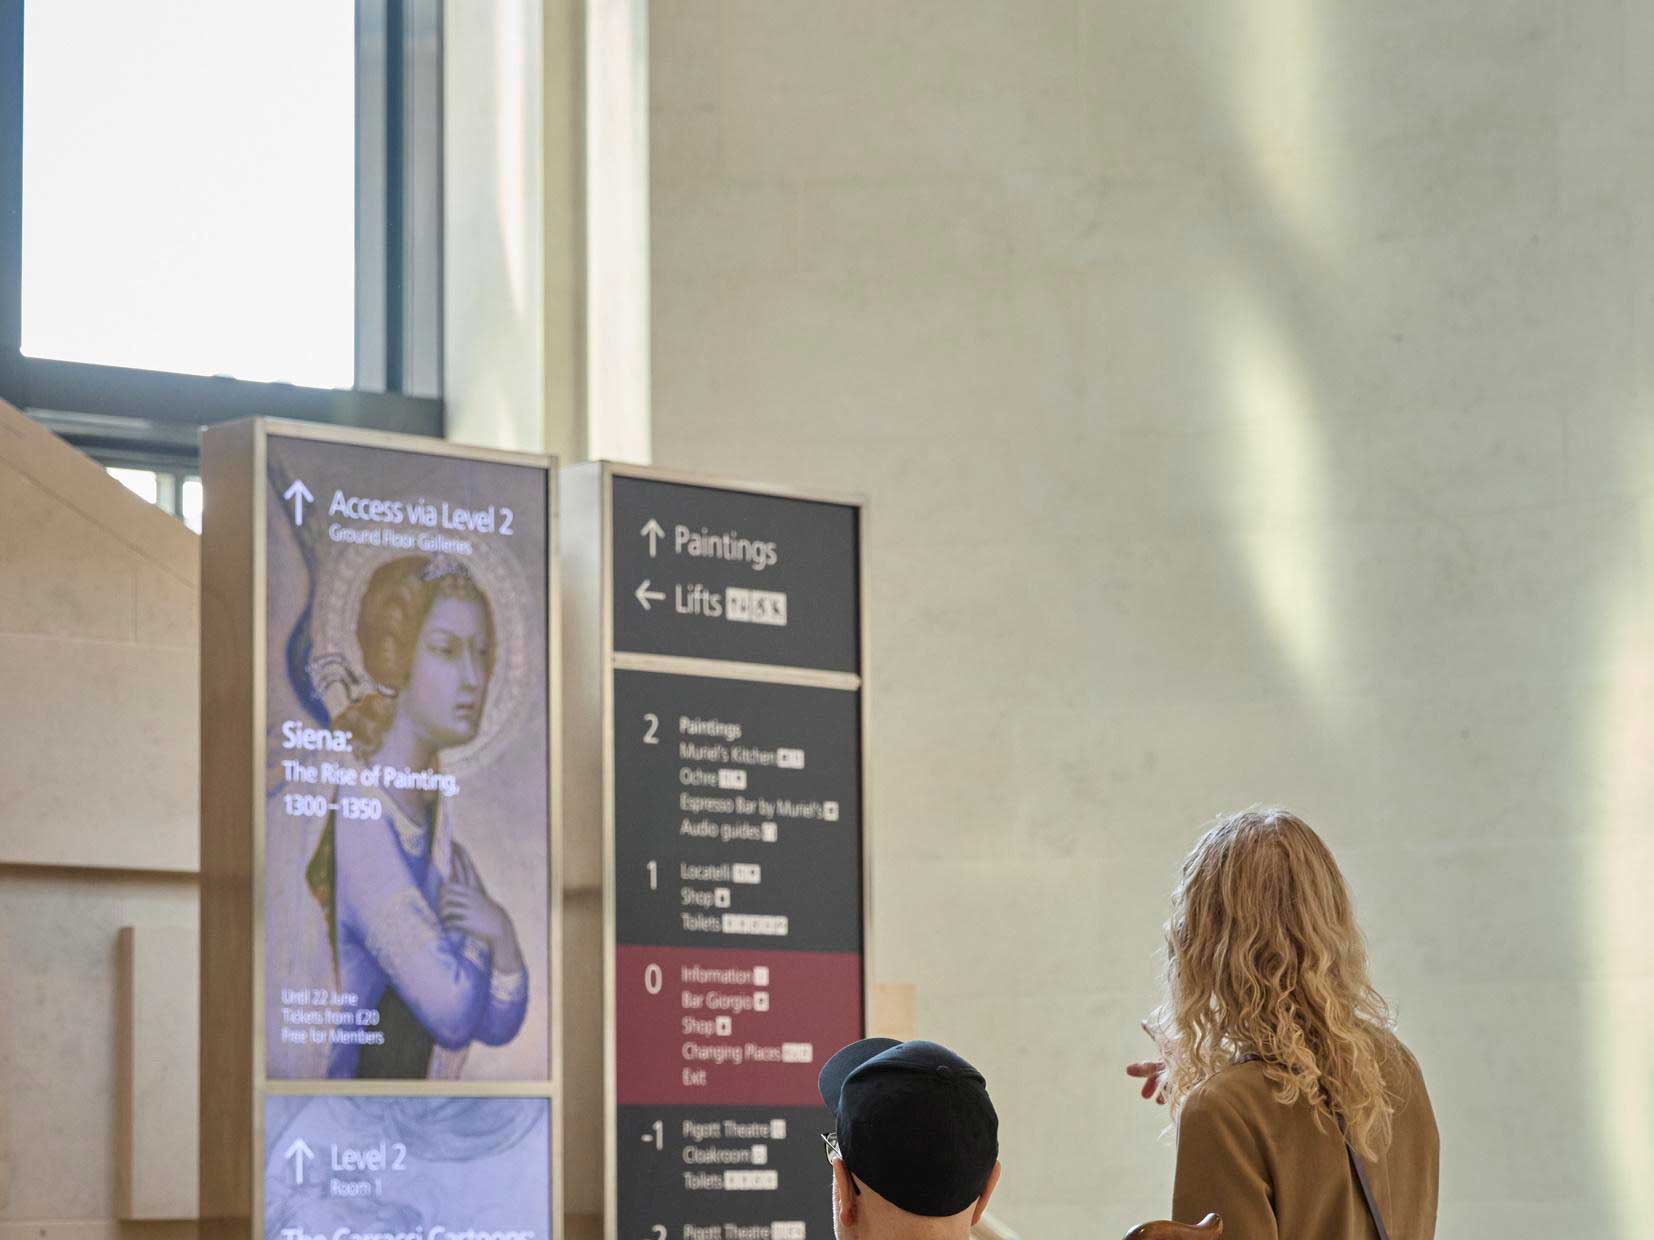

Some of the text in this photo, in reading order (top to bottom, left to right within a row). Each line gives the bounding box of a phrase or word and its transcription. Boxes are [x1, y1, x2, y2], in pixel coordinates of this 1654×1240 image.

[329, 490, 514, 535] Access via Level 2
[329, 523, 380, 546] Ground
[675, 524, 778, 571] Paintings
[675, 583, 723, 617] Lifts
[281, 720, 353, 752] Siena:
[643, 713, 659, 744] 2
[679, 715, 742, 741] Paintings
[731, 745, 777, 766] Kitchen
[282, 760, 460, 797] The Rise of Painting,
[679, 766, 718, 786] Ochre
[679, 791, 734, 814] Espresso
[736, 795, 757, 815] Bar
[680, 816, 761, 842] Audio guides
[646, 860, 658, 890] 1
[680, 887, 714, 909] Shop
[680, 912, 721, 932] Toilets
[644, 963, 662, 994] 0
[681, 964, 752, 984] Information
[281, 986, 359, 1006] Until 22 June
[681, 990, 704, 1009] Bar
[282, 1007, 380, 1025] Tickets from £20
[681, 1015, 715, 1038] Shop
[281, 1027, 384, 1045] Free for Members
[682, 1042, 781, 1064] Changing Places
[682, 1067, 706, 1086] Exit
[640, 1120, 663, 1150] -1
[723, 1119, 770, 1139] Theatre
[331, 1141, 407, 1171] Level 2
[331, 1179, 383, 1197] Room 1
[683, 1171, 724, 1190] Toilets
